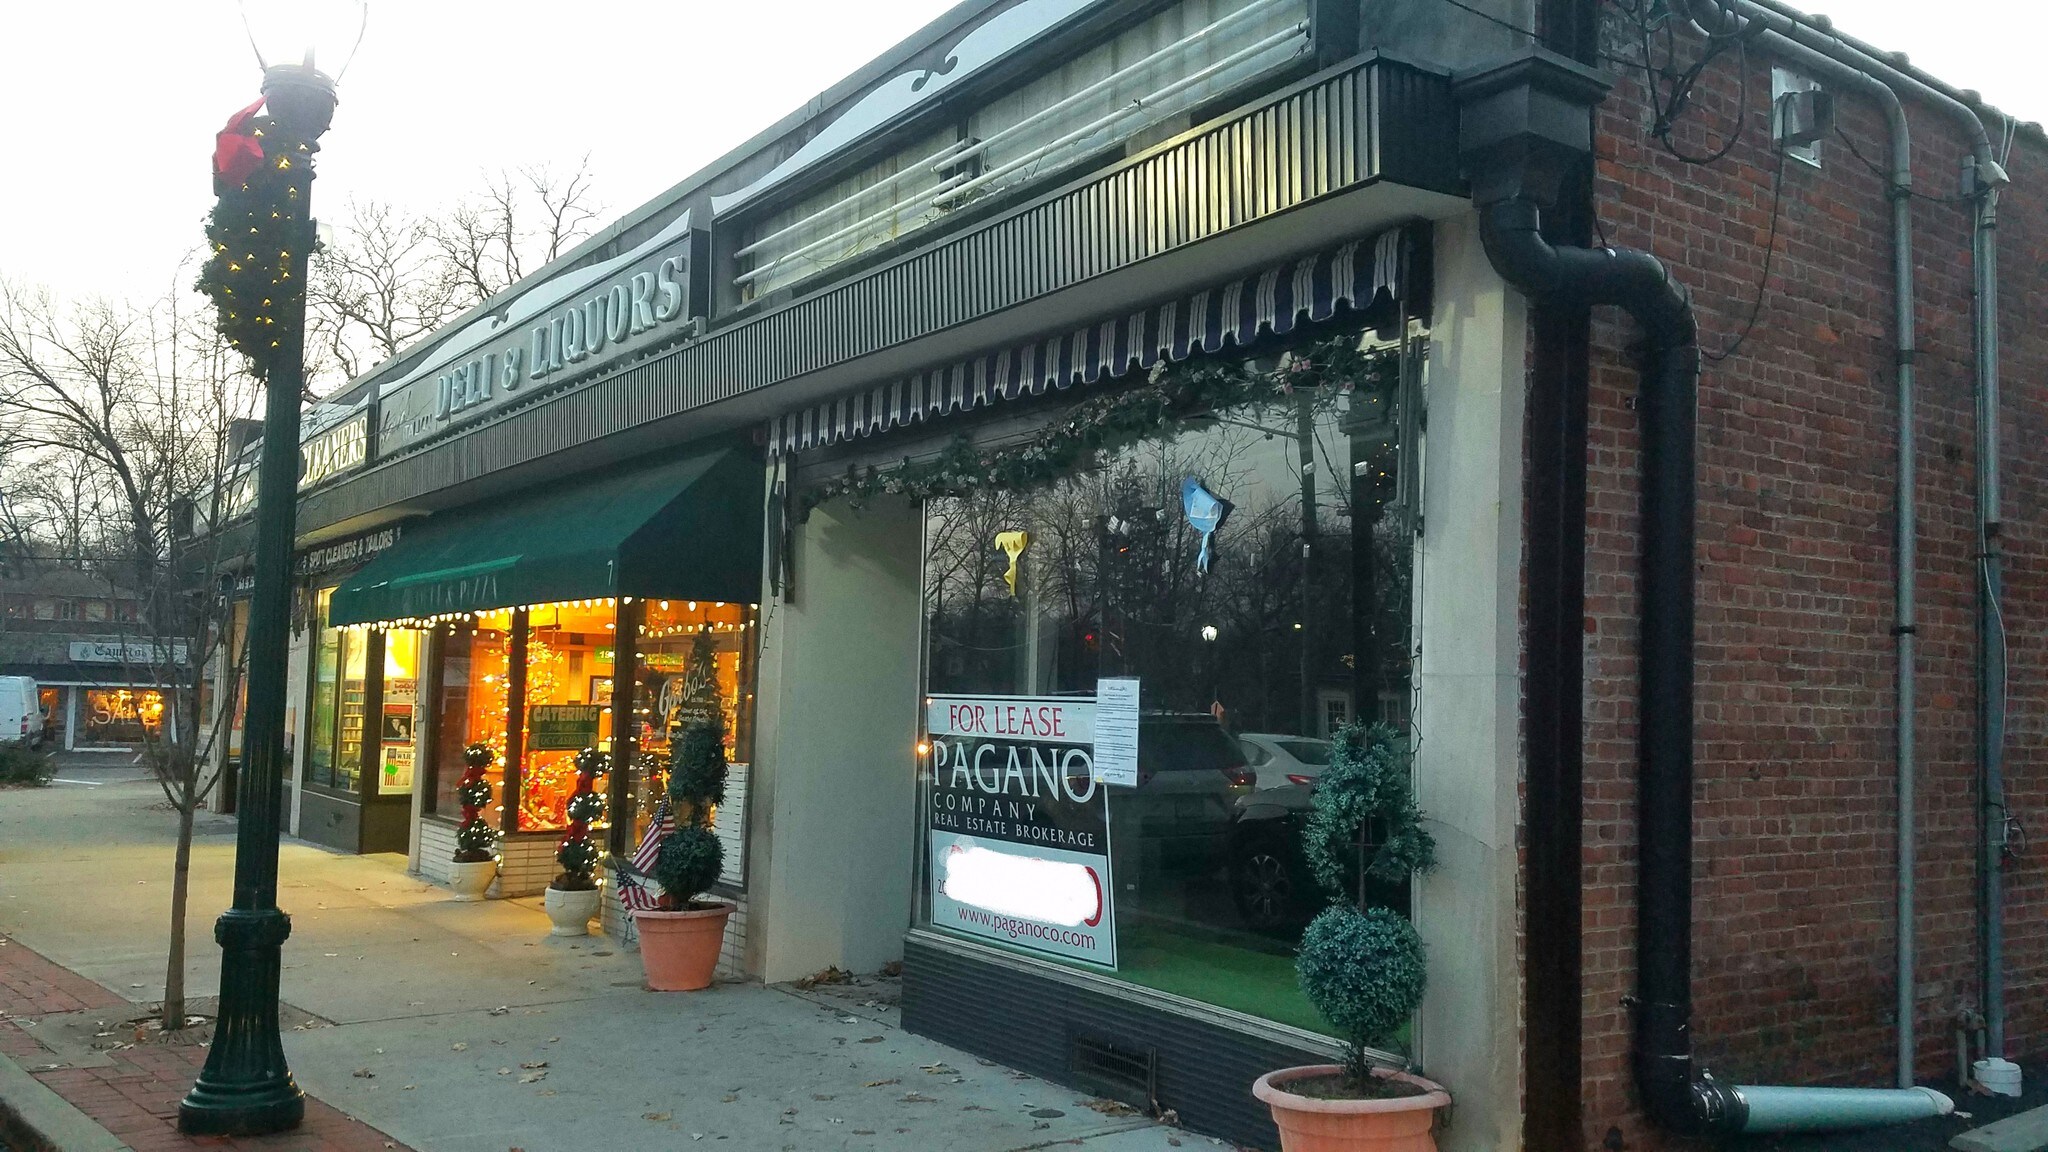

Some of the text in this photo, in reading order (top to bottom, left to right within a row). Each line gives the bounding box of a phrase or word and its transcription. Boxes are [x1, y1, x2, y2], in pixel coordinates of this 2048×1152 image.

[435, 353, 494, 421] DELI
[502, 347, 521, 391] &
[529, 254, 684, 380] LIQUORS
[325, 540, 357, 566] CLEANERS
[365, 528, 393, 554] TAILORS
[533, 706, 597, 722] CATERING
[950, 704, 1066, 737] FOR LEASE
[540, 734, 588, 745] OCCASIONS
[933, 740, 1096, 804] PAGANO
[934, 792, 1036, 822] COMPANY
[934, 813, 1095, 847] REAL ESTATE BROKERAGE
[958, 906, 1096, 950] www.paganoco.com
